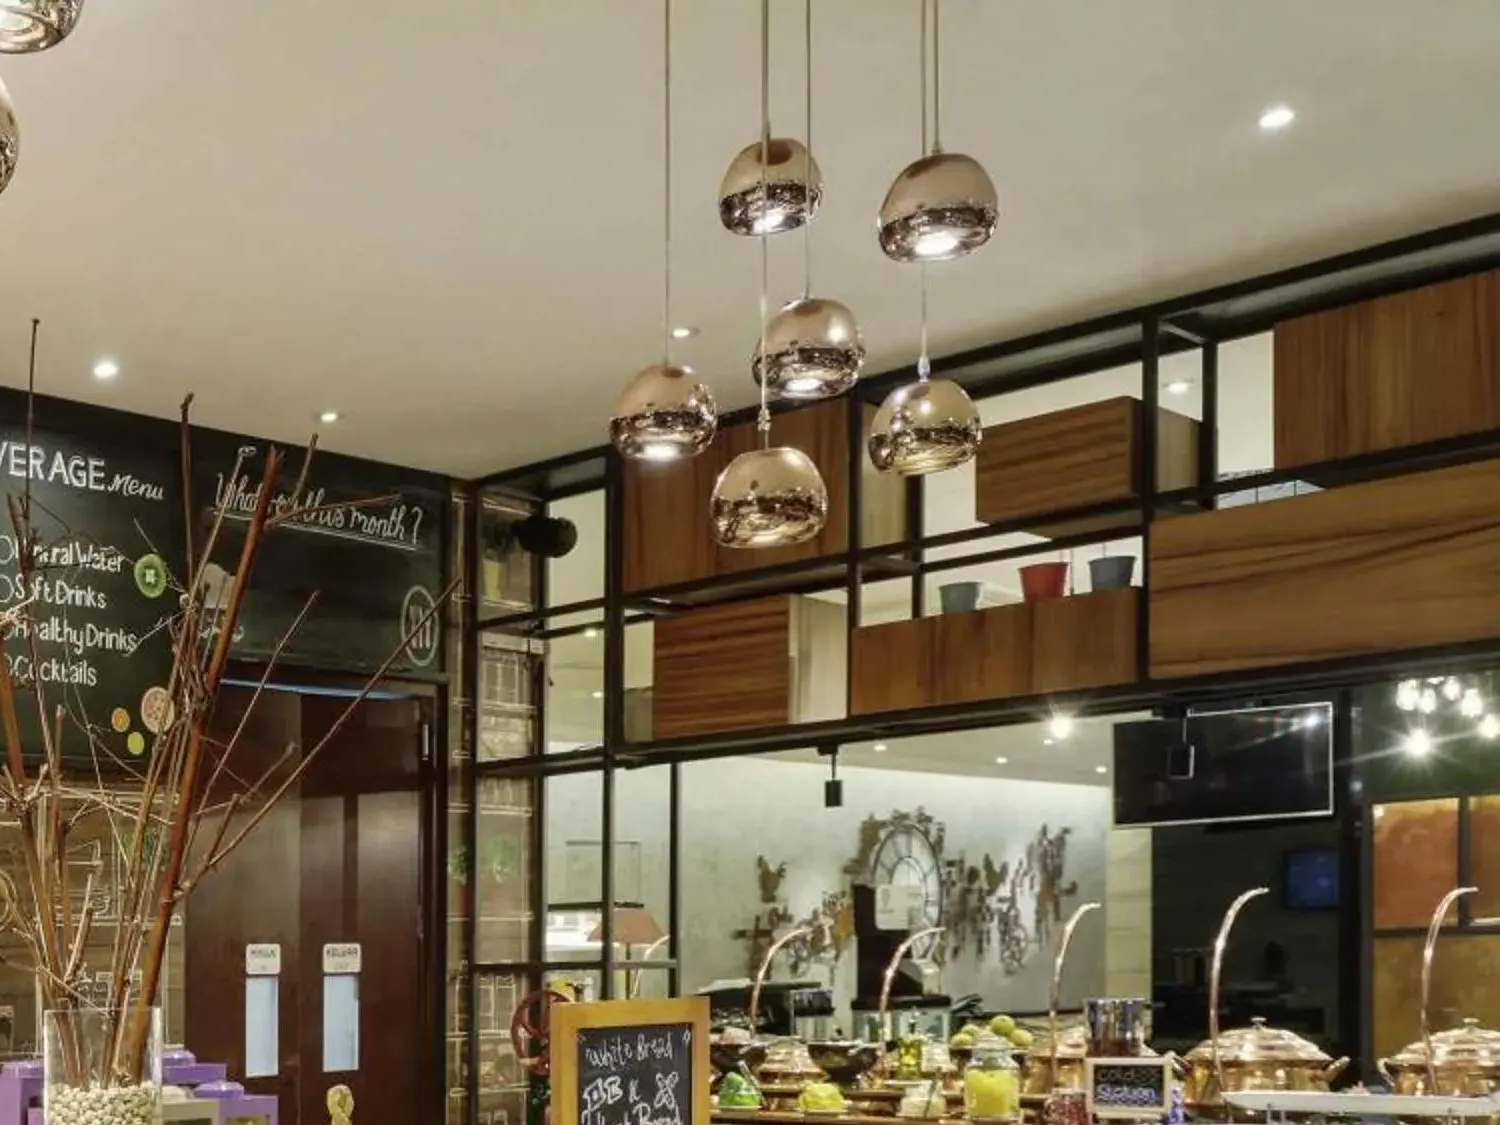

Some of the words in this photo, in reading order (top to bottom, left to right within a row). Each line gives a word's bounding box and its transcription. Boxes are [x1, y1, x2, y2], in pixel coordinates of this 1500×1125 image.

[107, 473, 165, 500] Menu
[74, 541, 125, 573] Water
[14, 573, 52, 603] Sft
[54, 579, 108, 609] Drinks
[15, 616, 84, 655] Halthy
[84, 622, 138, 651] Drinks
